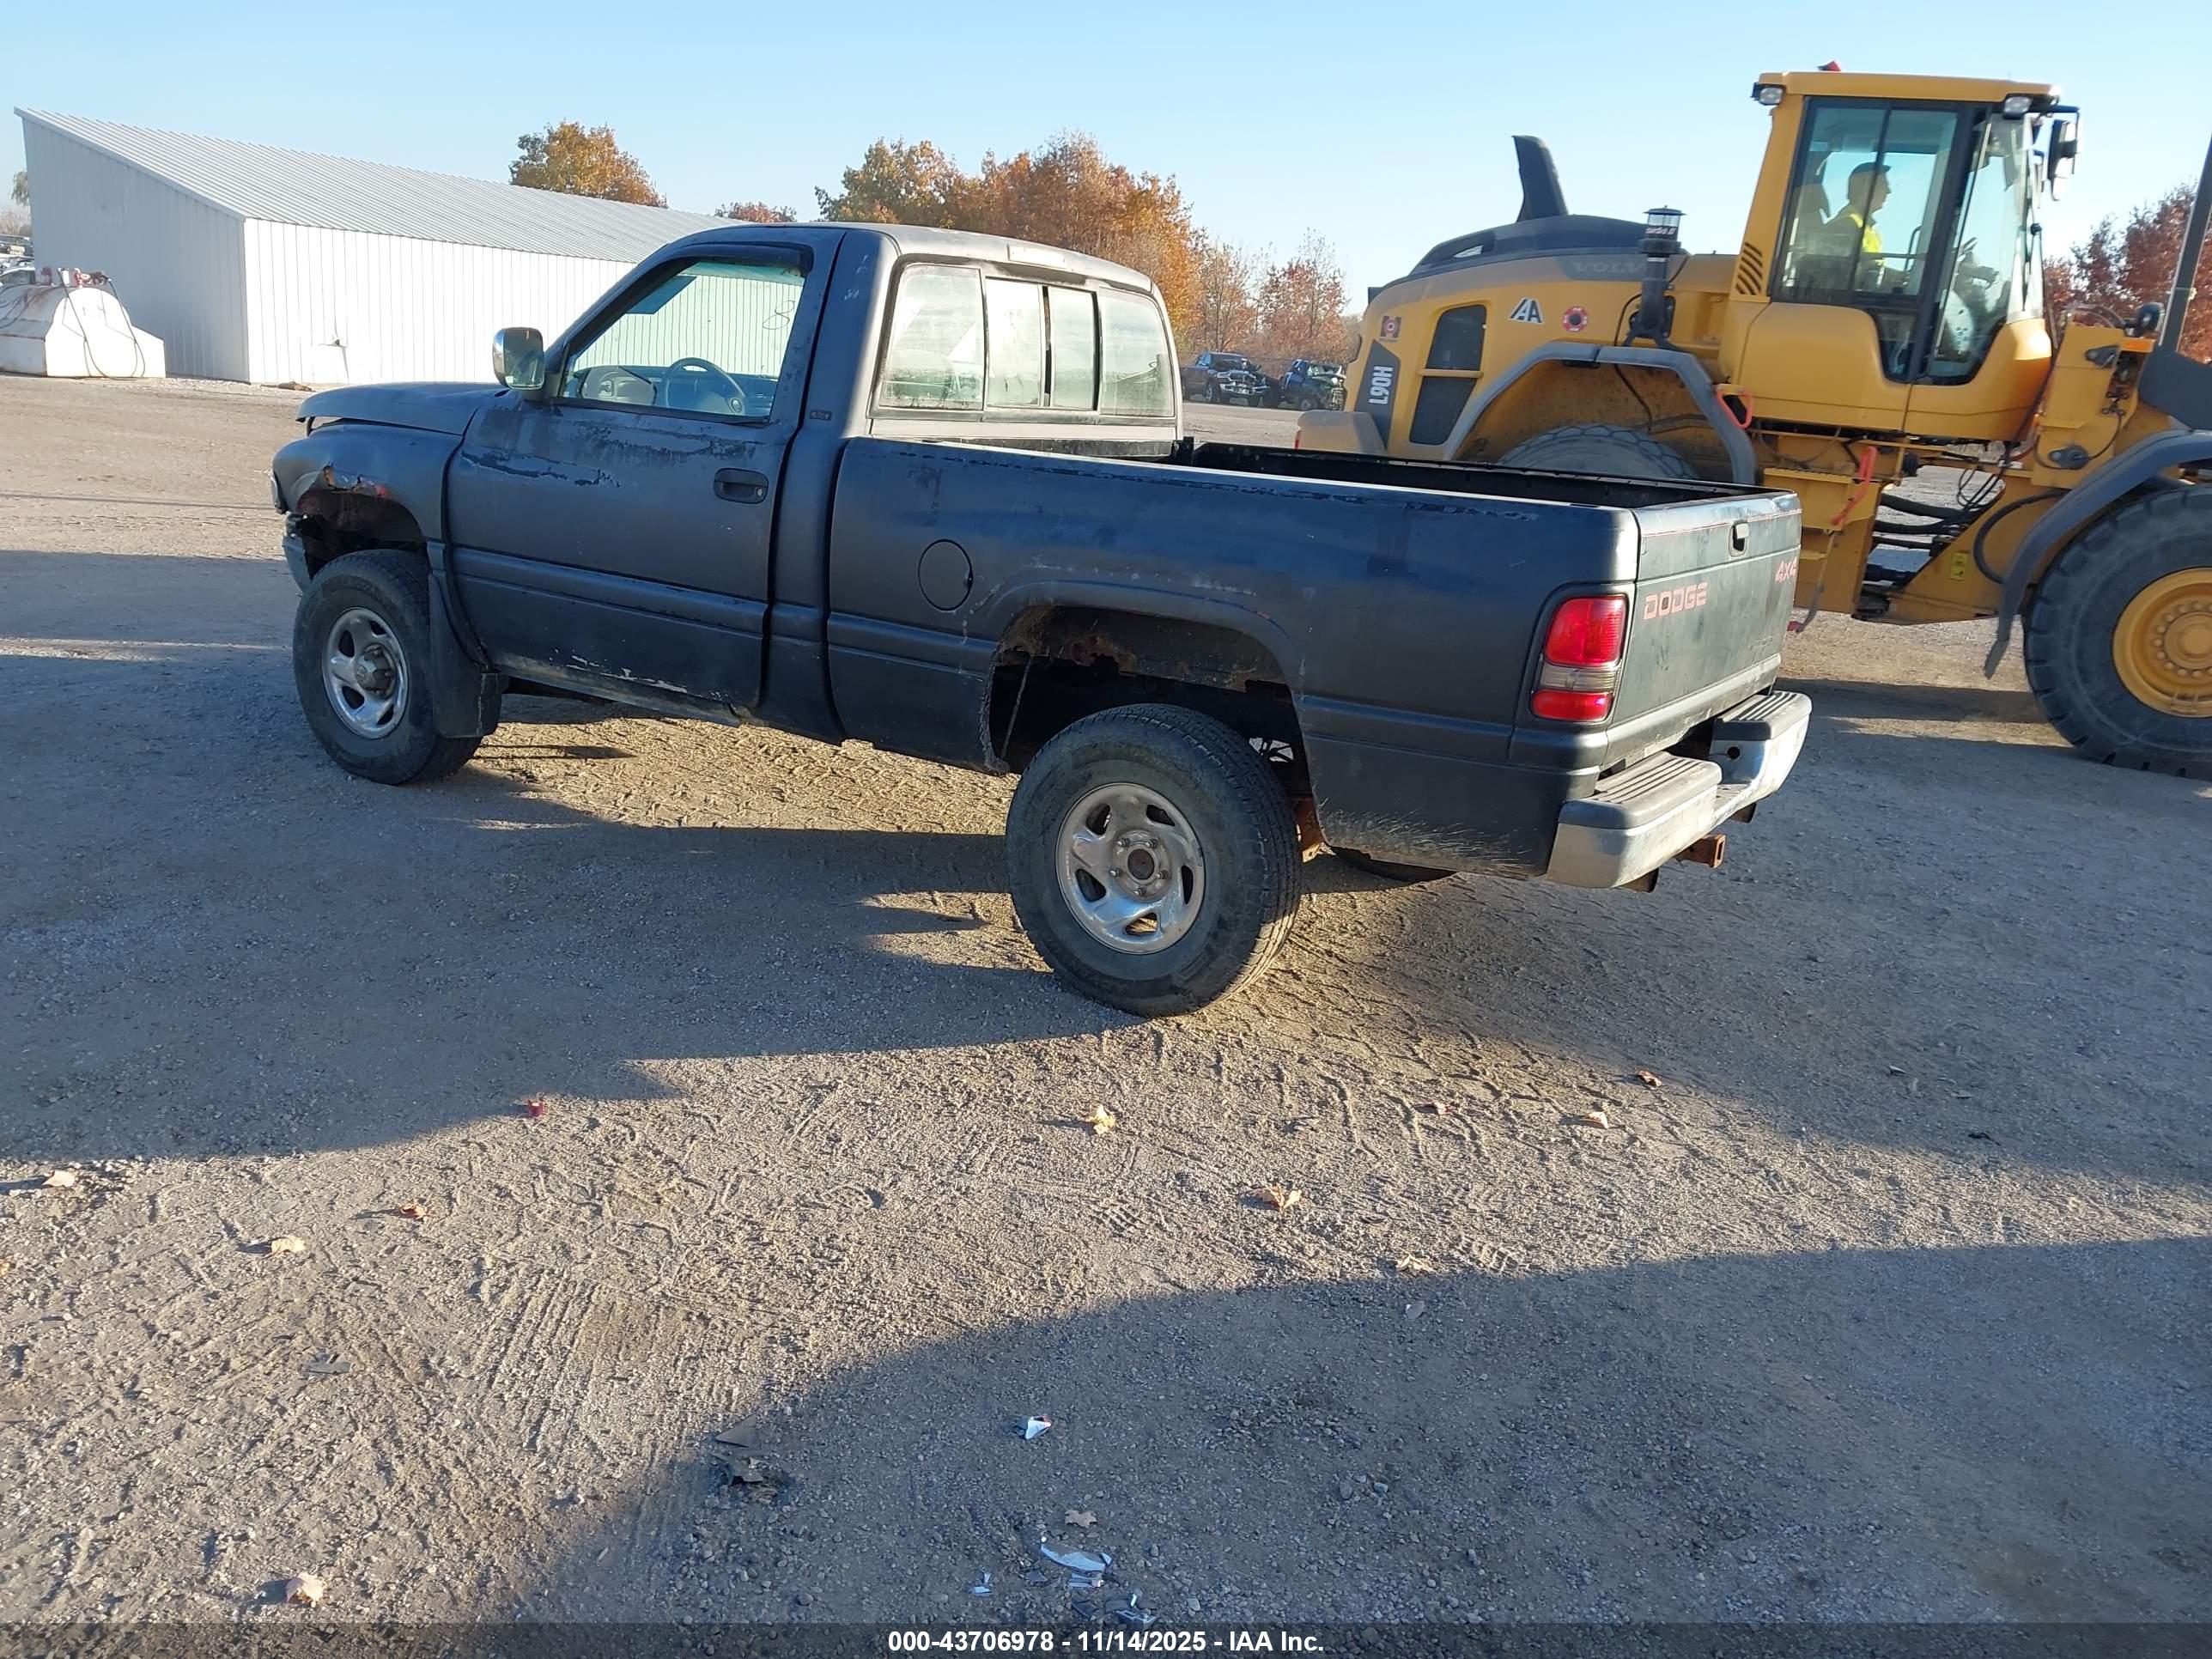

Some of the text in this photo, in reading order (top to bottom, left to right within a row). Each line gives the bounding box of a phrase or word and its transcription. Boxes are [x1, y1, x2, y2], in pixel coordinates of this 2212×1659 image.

[1573, 262, 1648, 273] VOLV
[1368, 366, 1394, 404] L90H
[1643, 582, 1708, 620] DODGE
